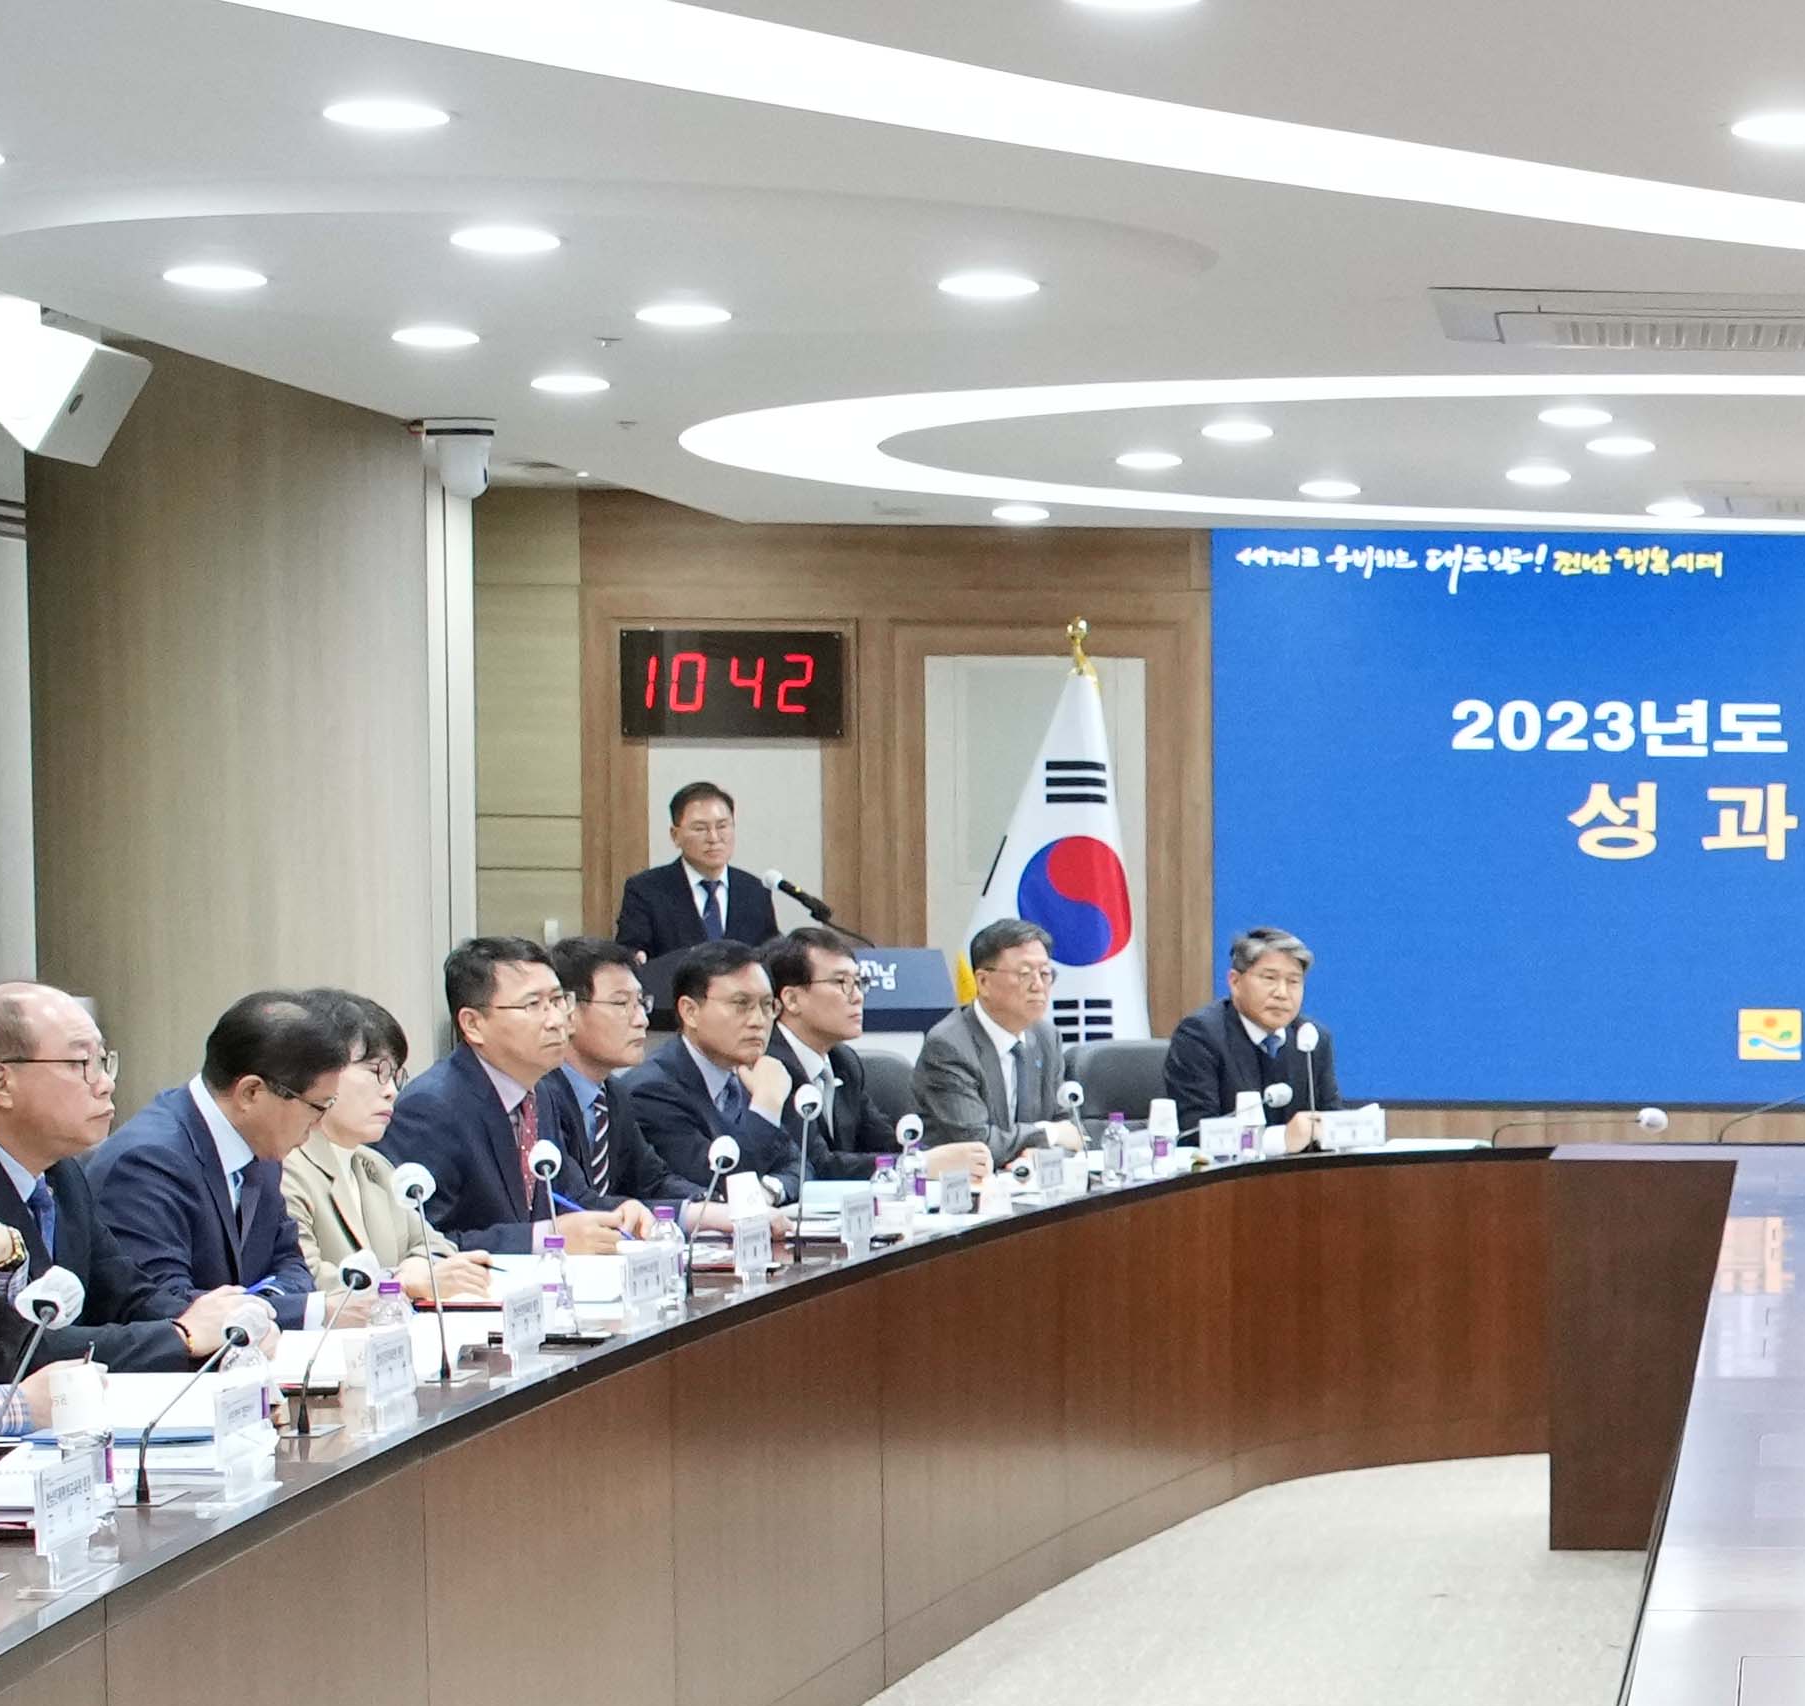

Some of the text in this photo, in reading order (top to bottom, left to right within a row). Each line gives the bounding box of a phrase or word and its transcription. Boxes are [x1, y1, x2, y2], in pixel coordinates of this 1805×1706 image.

[1236, 546, 1319, 568] 세계로
[1326, 545, 1417, 578] 웅비하는
[1426, 544, 1547, 594] 대도약!
[1553, 550, 1612, 576] 전남
[1451, 699, 1789, 758] 2023년도
